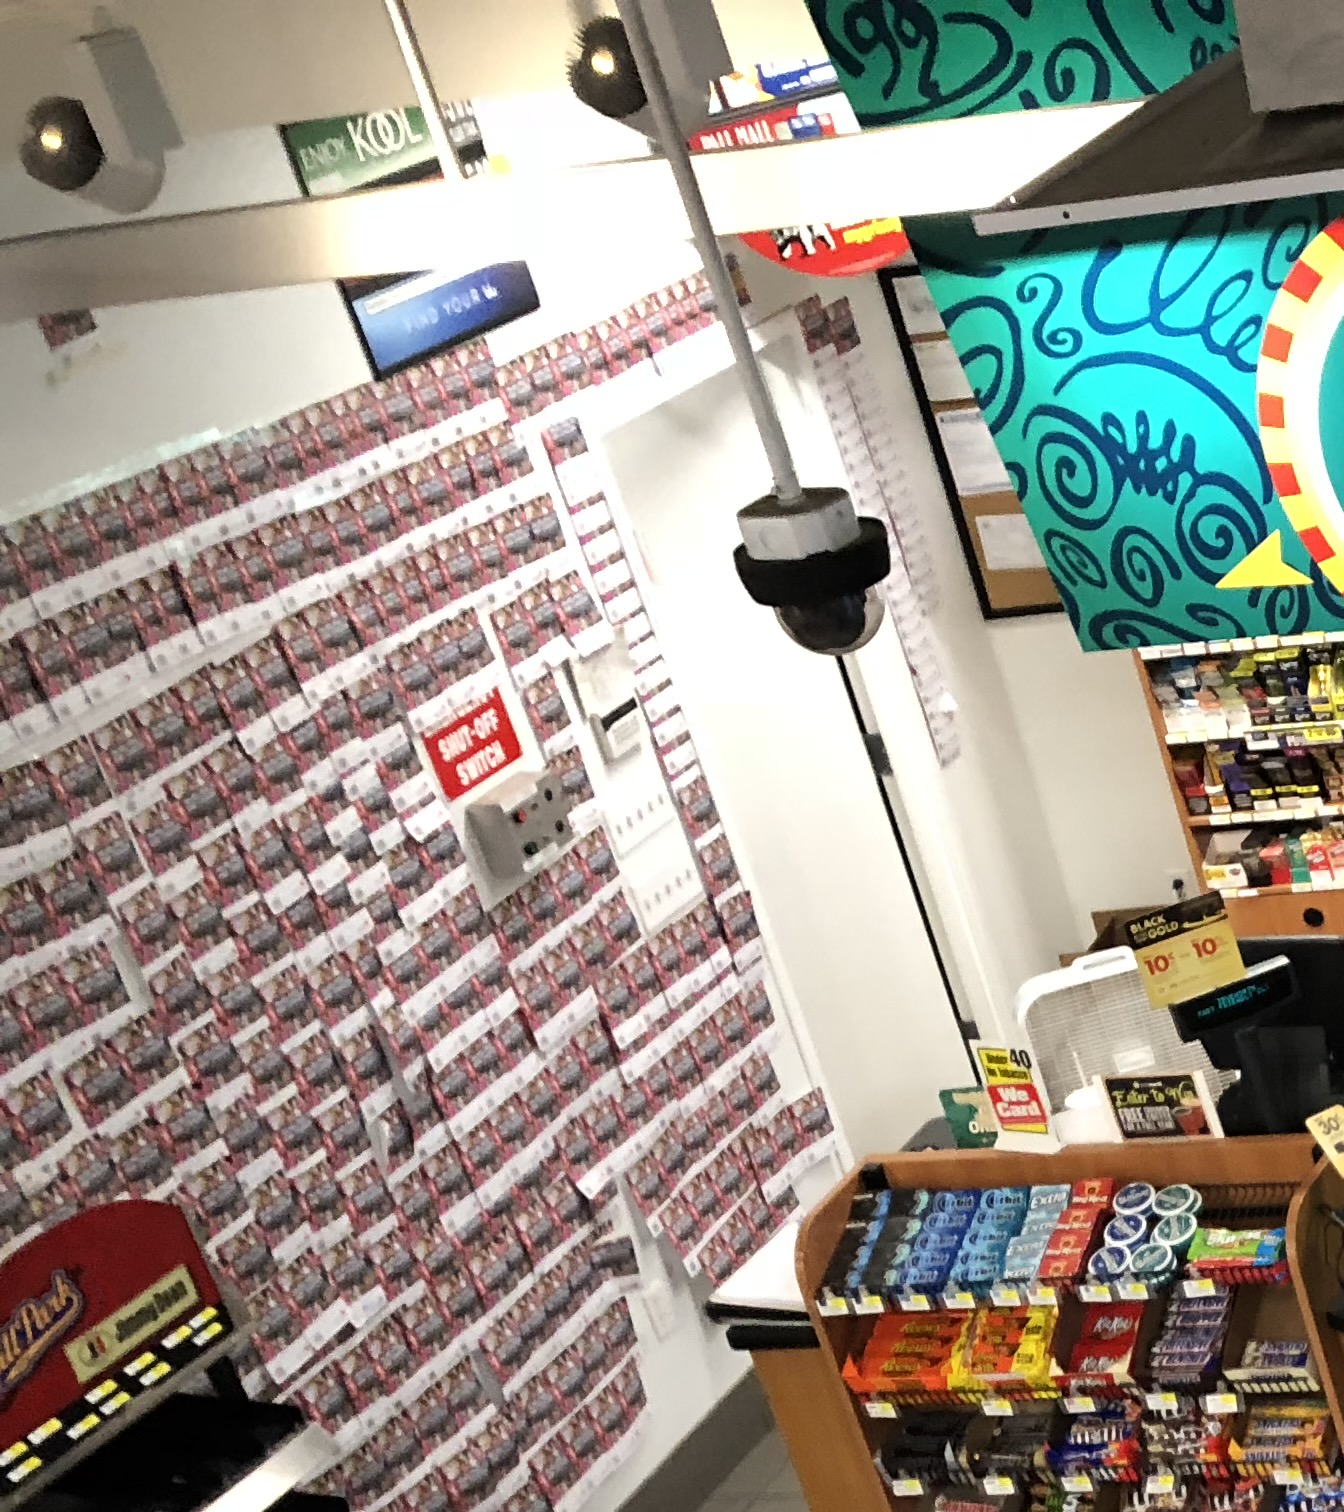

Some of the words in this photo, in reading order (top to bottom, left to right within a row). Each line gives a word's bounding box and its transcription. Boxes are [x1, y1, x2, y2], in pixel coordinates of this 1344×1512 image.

[347, 106, 423, 162] KOOL
[437, 707, 500, 763] SHUT-OFF
[455, 740, 508, 787] SWITCH
[1130, 914, 1167, 934] BLACK
[1148, 921, 1179, 939] GOLD
[1010, 1049, 1032, 1070] 40
[996, 1087, 1029, 1104] We
[996, 1100, 1041, 1118] Card
